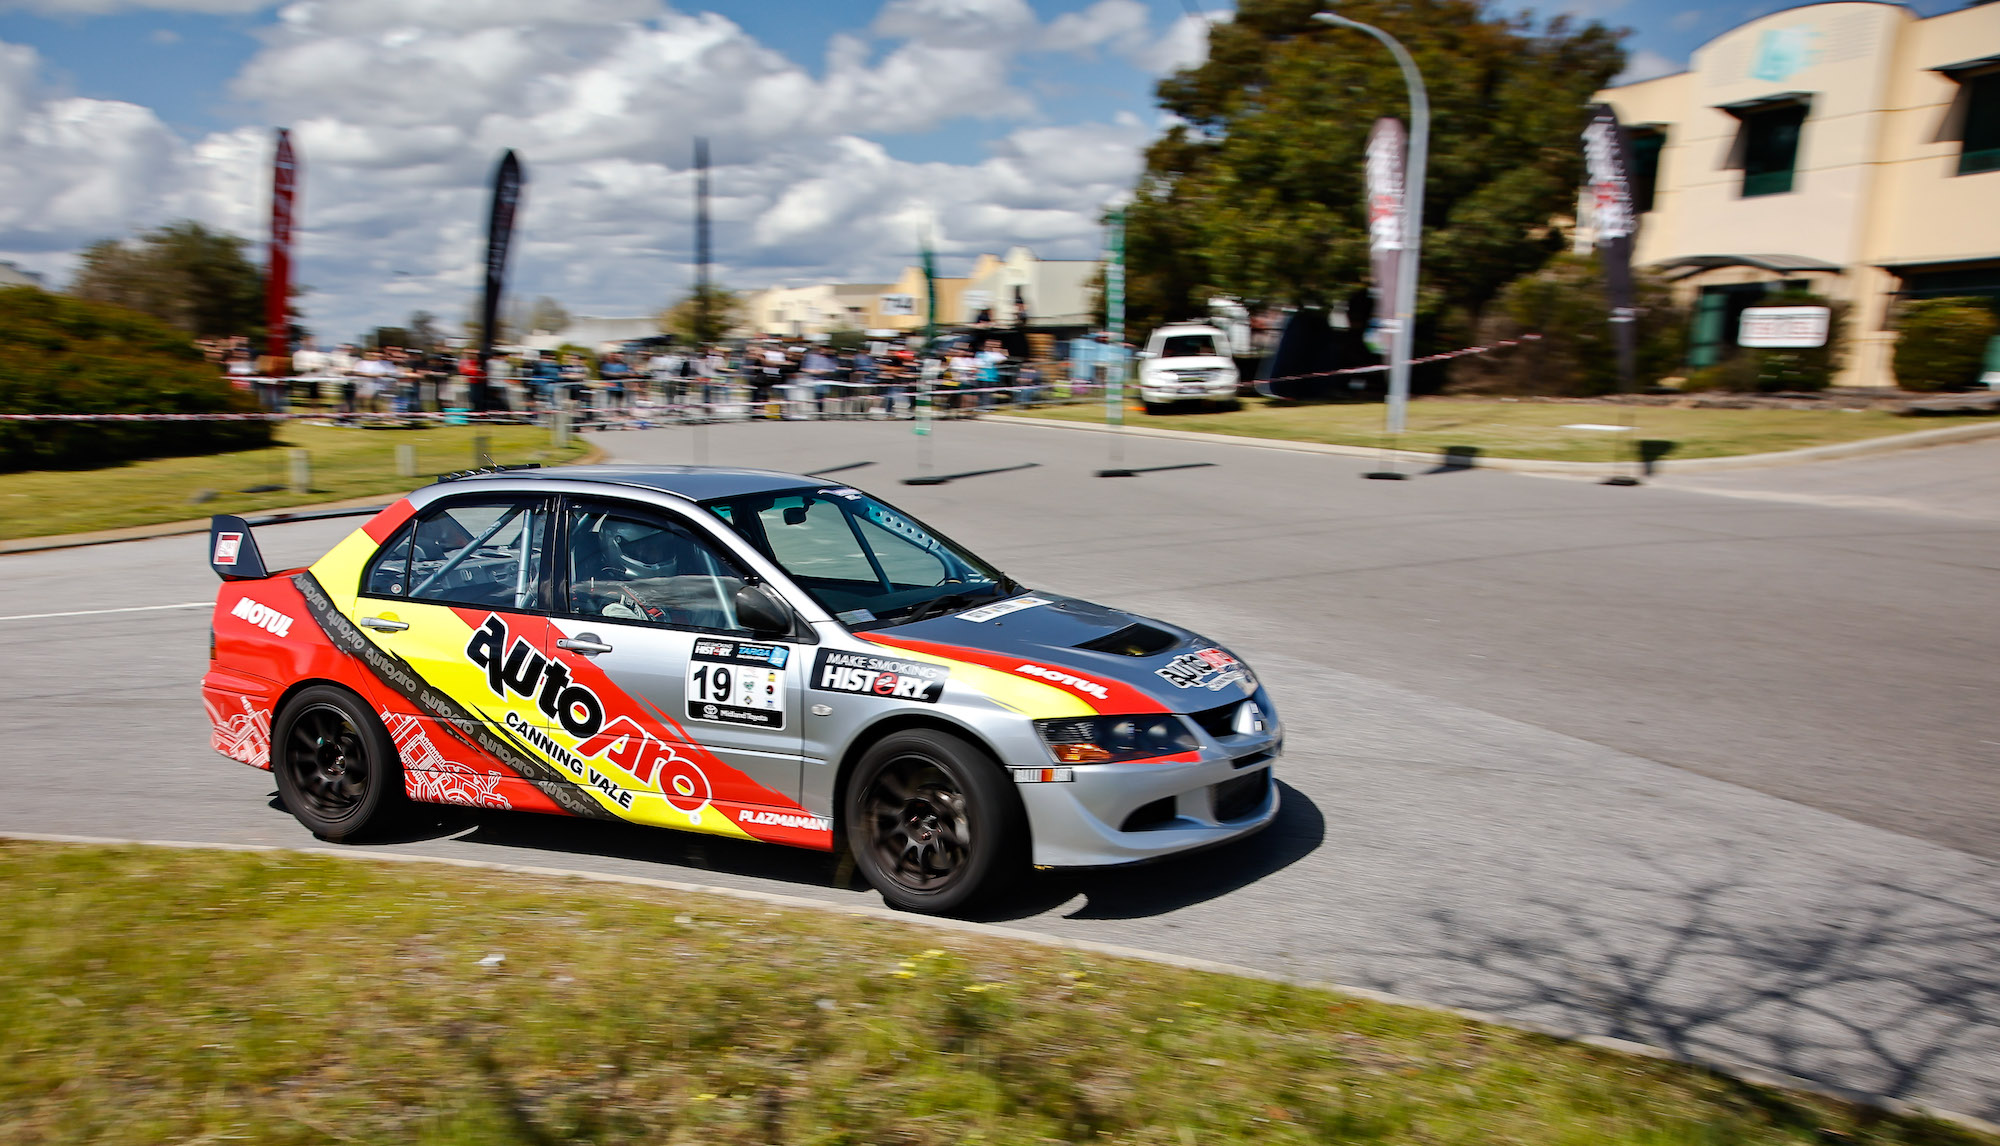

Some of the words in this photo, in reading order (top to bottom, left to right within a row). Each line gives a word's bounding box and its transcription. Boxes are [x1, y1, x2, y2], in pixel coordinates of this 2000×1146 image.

[231, 597, 294, 637] MOTUL
[738, 647, 770, 657] TARGA
[825, 653, 868, 668] MAKE
[867, 658, 938, 678] SMOKING
[693, 665, 731, 702] 19
[1015, 664, 1108, 699] MOTUL
[506, 711, 584, 777] CANNING
[589, 768, 632, 809] VALE
[738, 809, 829, 831] PLAZMAMAN
